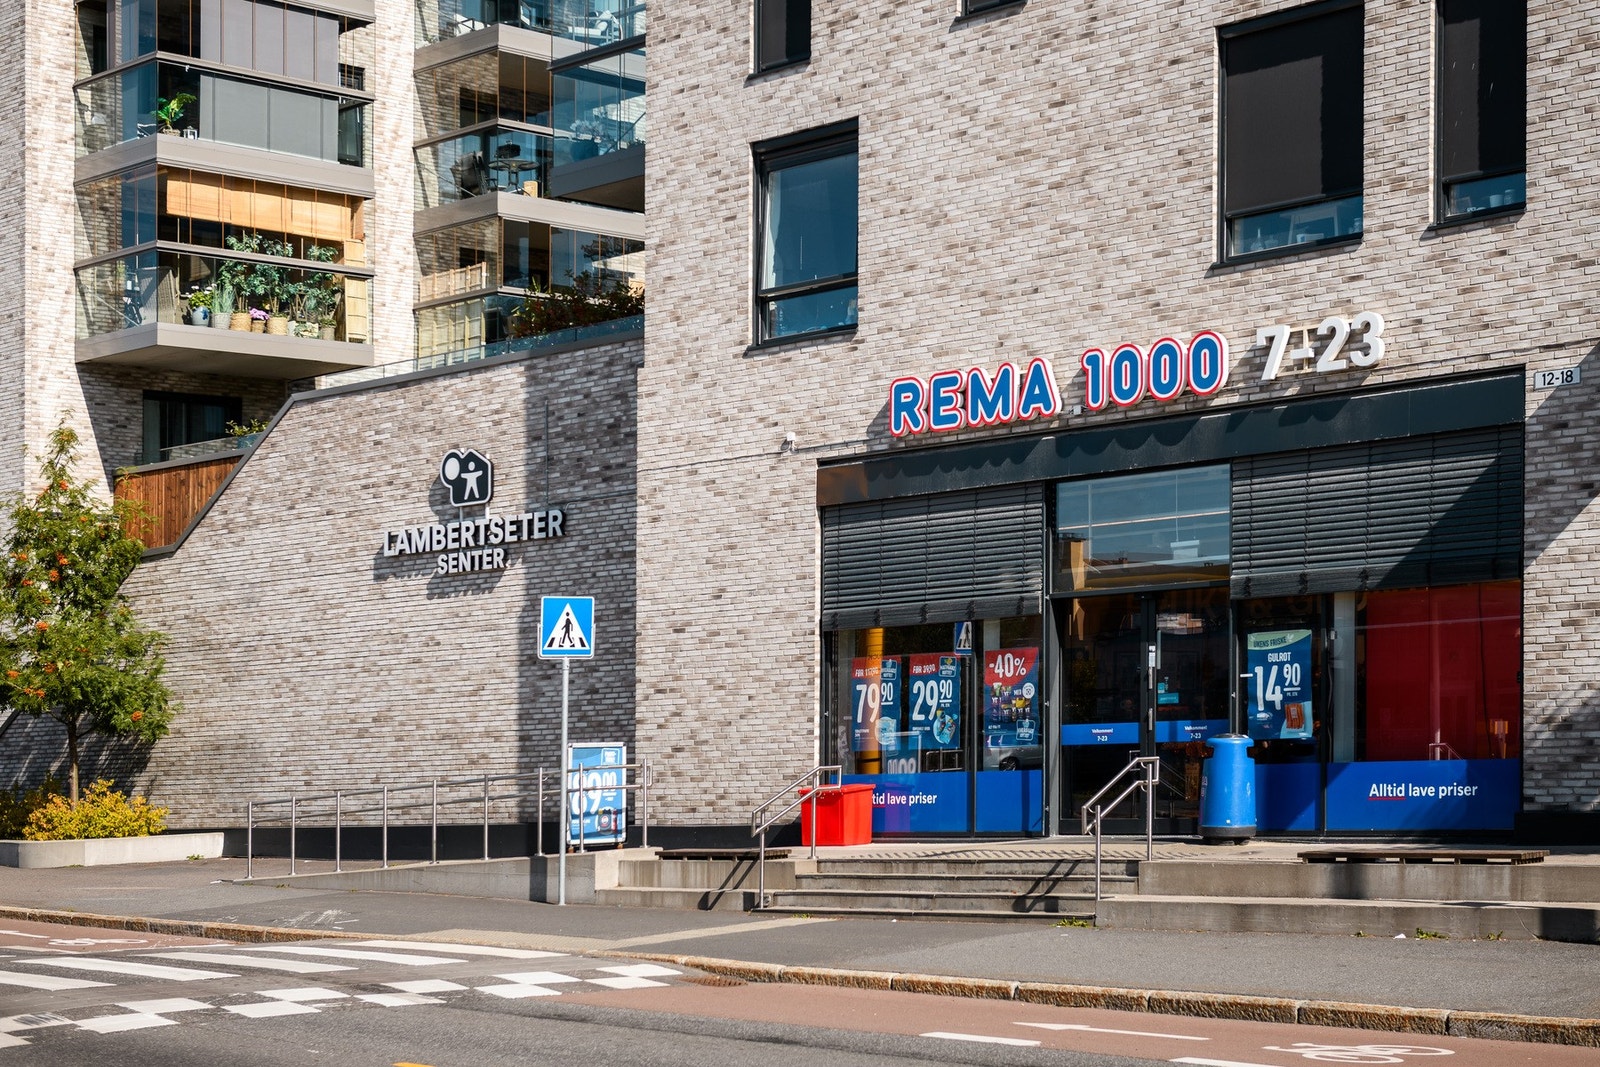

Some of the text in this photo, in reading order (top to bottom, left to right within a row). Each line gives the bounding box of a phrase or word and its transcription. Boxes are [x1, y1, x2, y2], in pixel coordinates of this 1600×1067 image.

[1256, 310, 1386, 382] 7-23
[889, 330, 1229, 438] REMA 1000
[1542, 369, 1574, 386] 12-18
[383, 509, 566, 557] LAMBERTSETER
[437, 548, 506, 575] SENTER
[989, 653, 1027, 678] -40%
[1267, 652, 1292, 662] GULROT
[855, 682, 894, 723] 79 90
[912, 679, 953, 721] 29 90
[1254, 663, 1301, 711] 14 90
[872, 792, 938, 807] tid lave priser
[1369, 782, 1478, 799] Alltid lave priser
